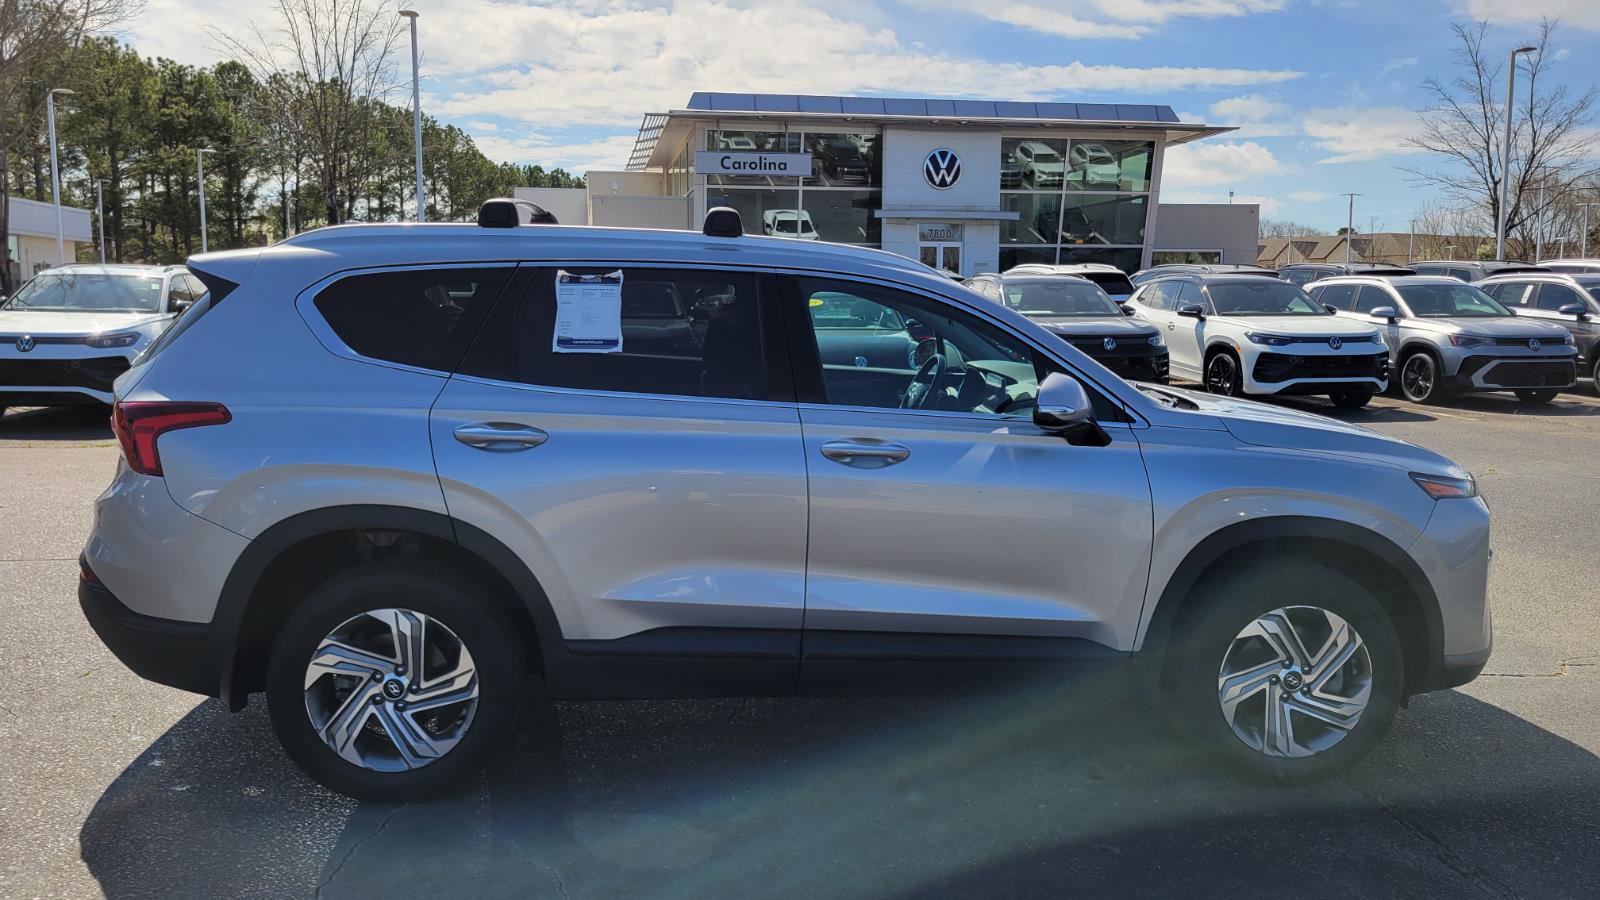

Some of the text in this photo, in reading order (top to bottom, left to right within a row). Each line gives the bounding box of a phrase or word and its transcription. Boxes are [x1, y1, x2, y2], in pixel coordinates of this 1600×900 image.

[720, 155, 787, 171] Carolina
[924, 149, 962, 190] VW
[928, 228, 952, 239] 7800
